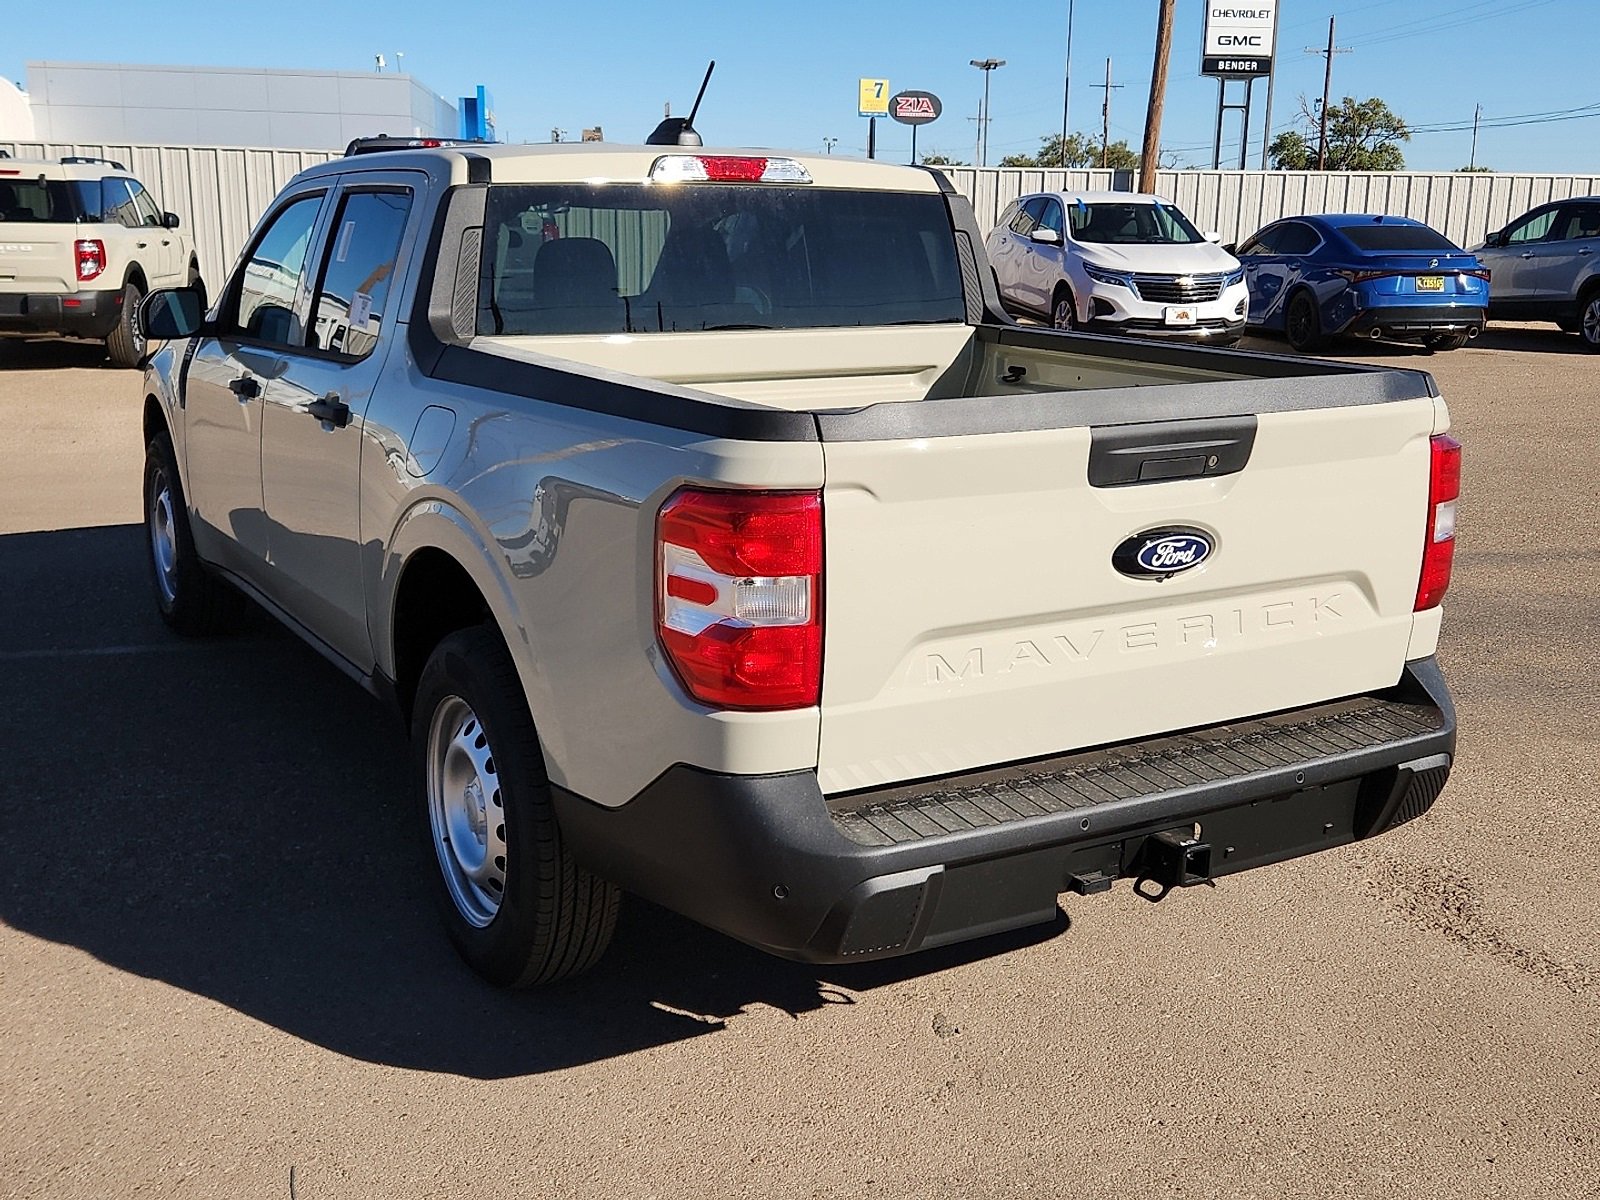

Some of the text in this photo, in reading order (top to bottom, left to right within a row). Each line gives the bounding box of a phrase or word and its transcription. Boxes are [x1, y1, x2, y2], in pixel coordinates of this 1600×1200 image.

[1212, 8, 1271, 19] CHEVROLET
[1217, 35, 1261, 46] GMC
[1217, 60, 1258, 71] BENDER
[874, 82, 884, 98] 7
[896, 96, 934, 113] ZIA
[1151, 540, 1197, 567] Ford
[923, 593, 1343, 686] MAVERICK
